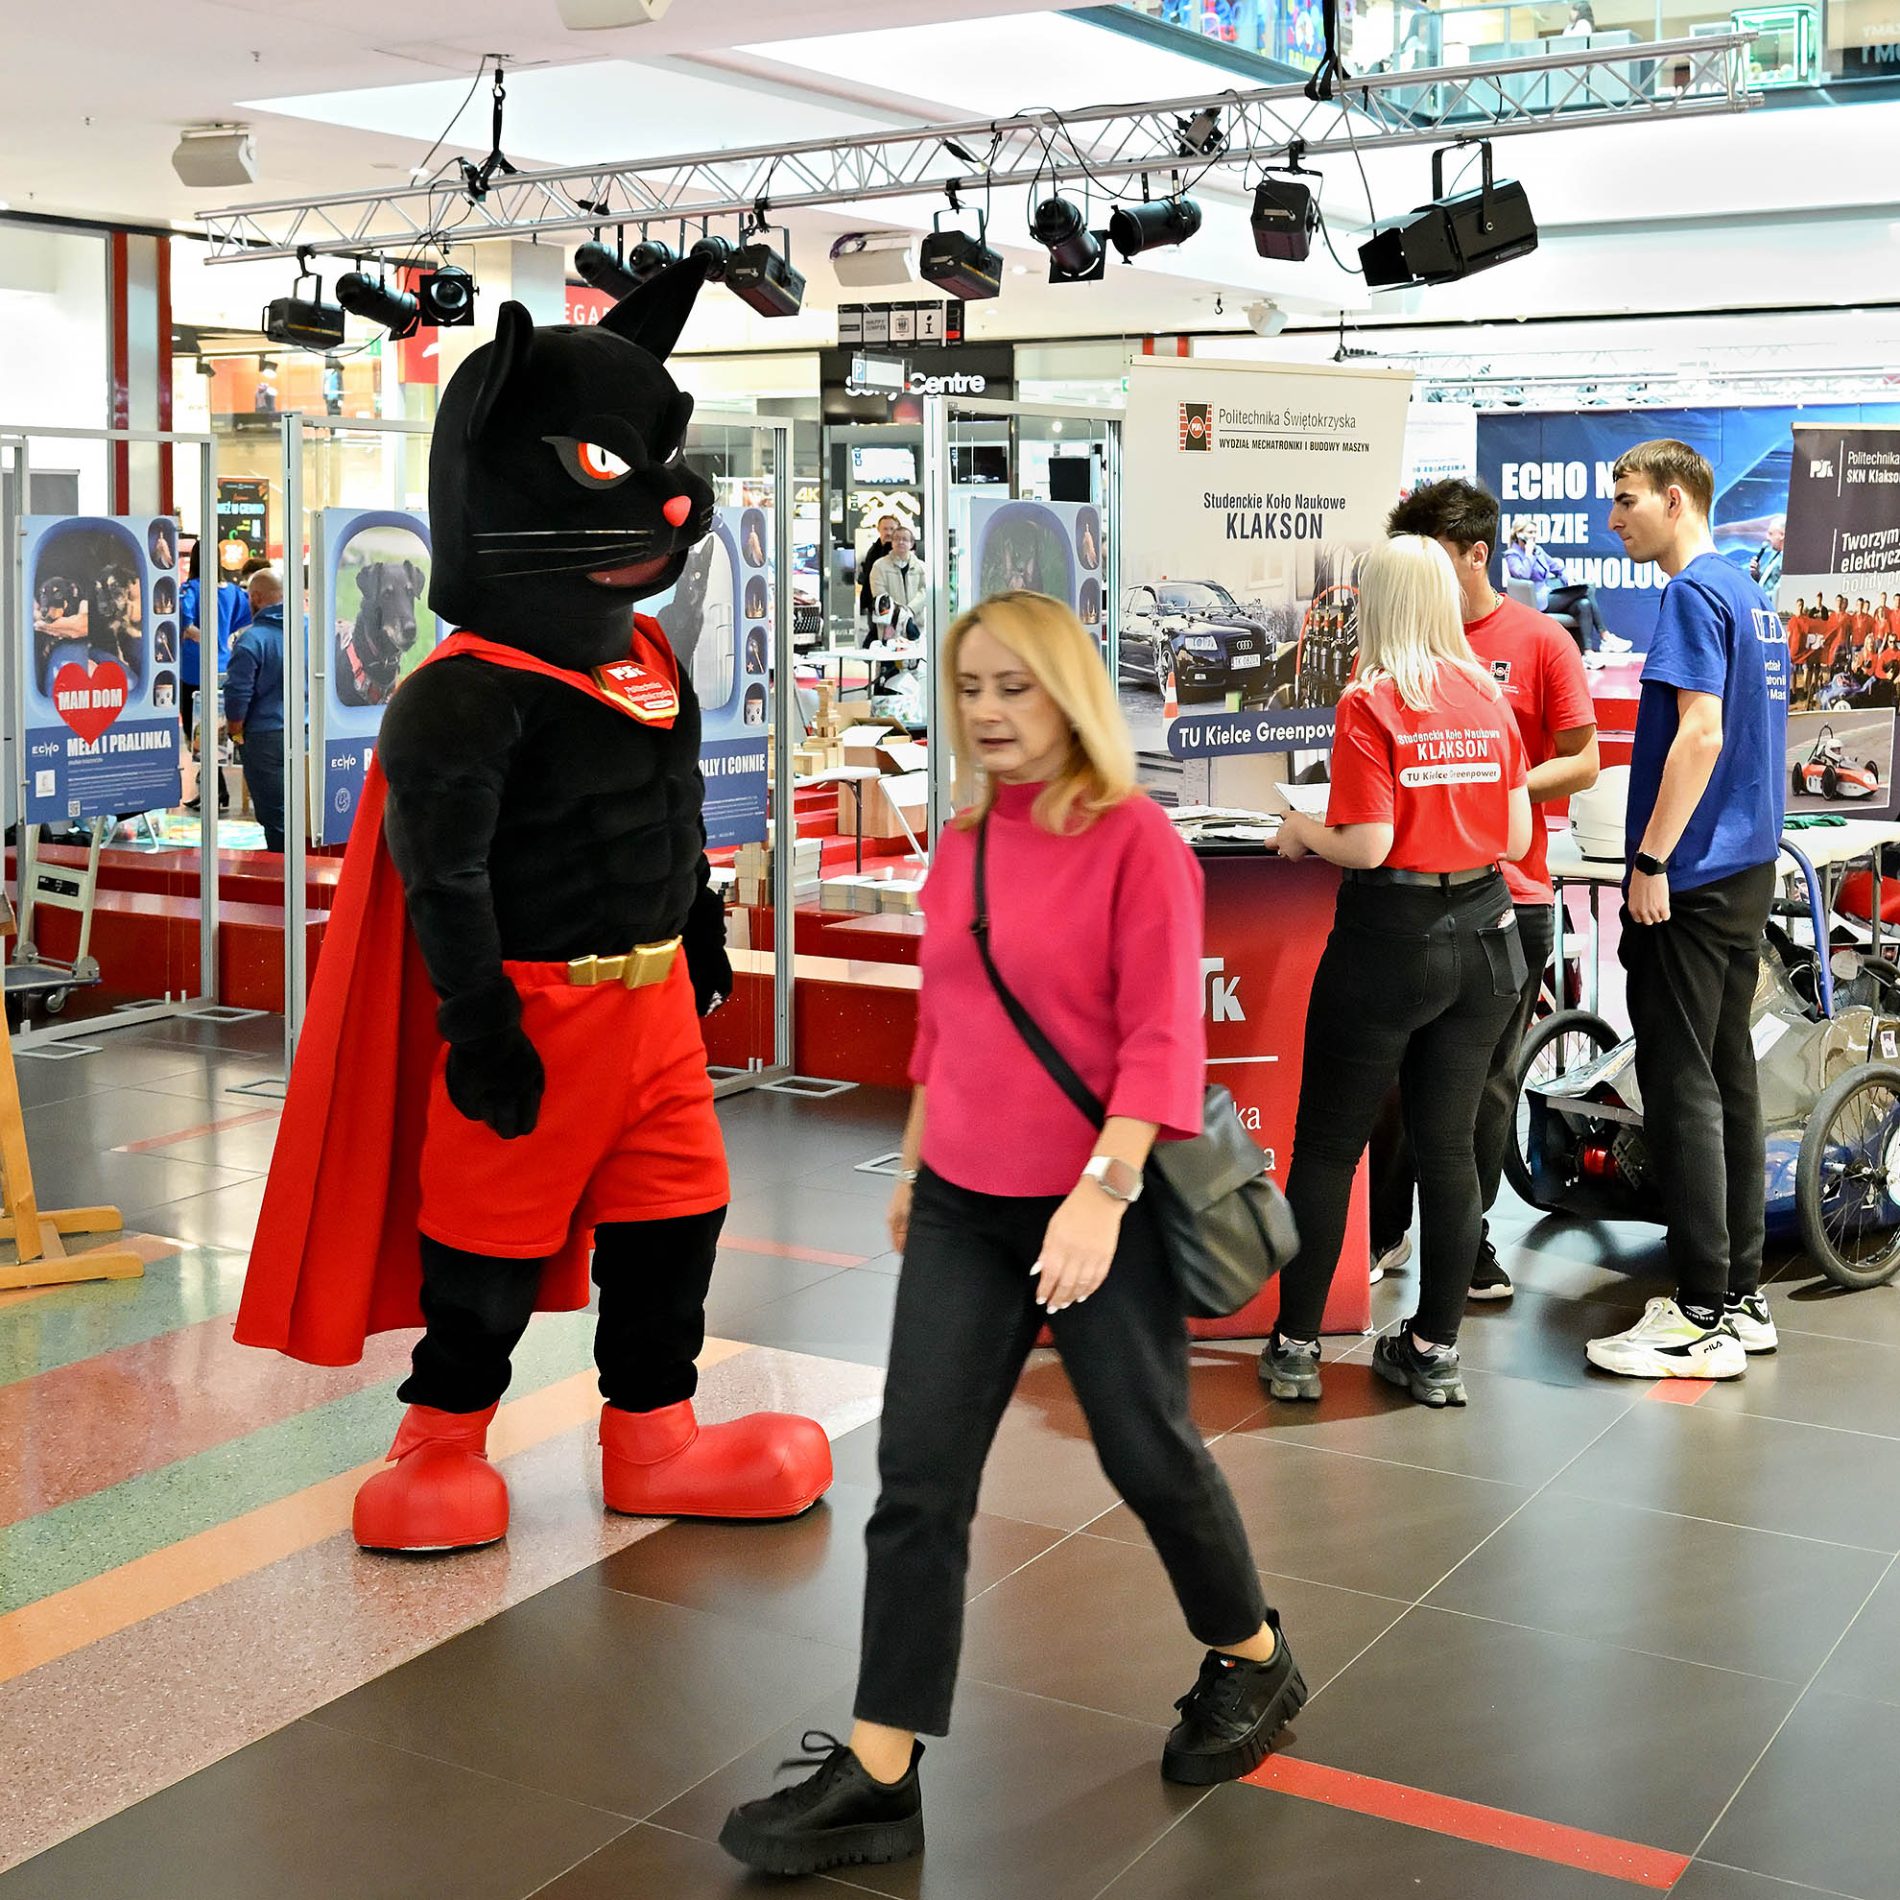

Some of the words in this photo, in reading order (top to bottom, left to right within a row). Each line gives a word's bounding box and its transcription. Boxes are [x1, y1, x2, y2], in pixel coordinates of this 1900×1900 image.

[910, 372, 985, 396] Centre
[1218, 408, 1280, 426] Politechnika
[1283, 408, 1356, 431] Świętokrzyska
[1219, 437, 1250, 450] WYDZIAŁ
[1251, 440, 1303, 451] MECHATRONIKI
[1309, 441, 1340, 452] BUDOWY
[1342, 443, 1370, 453] MASZYN
[1847, 451, 1900, 467] Politechnika
[1501, 461, 1588, 501] ECHO
[1846, 469, 1866, 484] SKN
[1868, 469, 1900, 484] Klakso
[1203, 492, 1263, 509] Studenckie
[1266, 494, 1291, 510] Koło
[1295, 494, 1346, 510] Naukowe
[1226, 513, 1324, 540] KLAKSON
[1841, 528, 1900, 553] Tworzym
[1841, 571, 1883, 595] bolidy
[58, 690, 90, 711] MAM
[92, 688, 123, 708] DOM
[109, 730, 172, 753] PRALINKA
[1179, 727, 1201, 748] TU
[1206, 724, 1252, 746] Kielce
[31, 741, 60, 759] ECHO
[1417, 740, 1488, 761] KLAKSON
[331, 752, 357, 771] ECHO
[728, 753, 766, 775] CONNIE
[1407, 773, 1420, 782] TU
[1703, 1340, 1723, 1354] FILA
